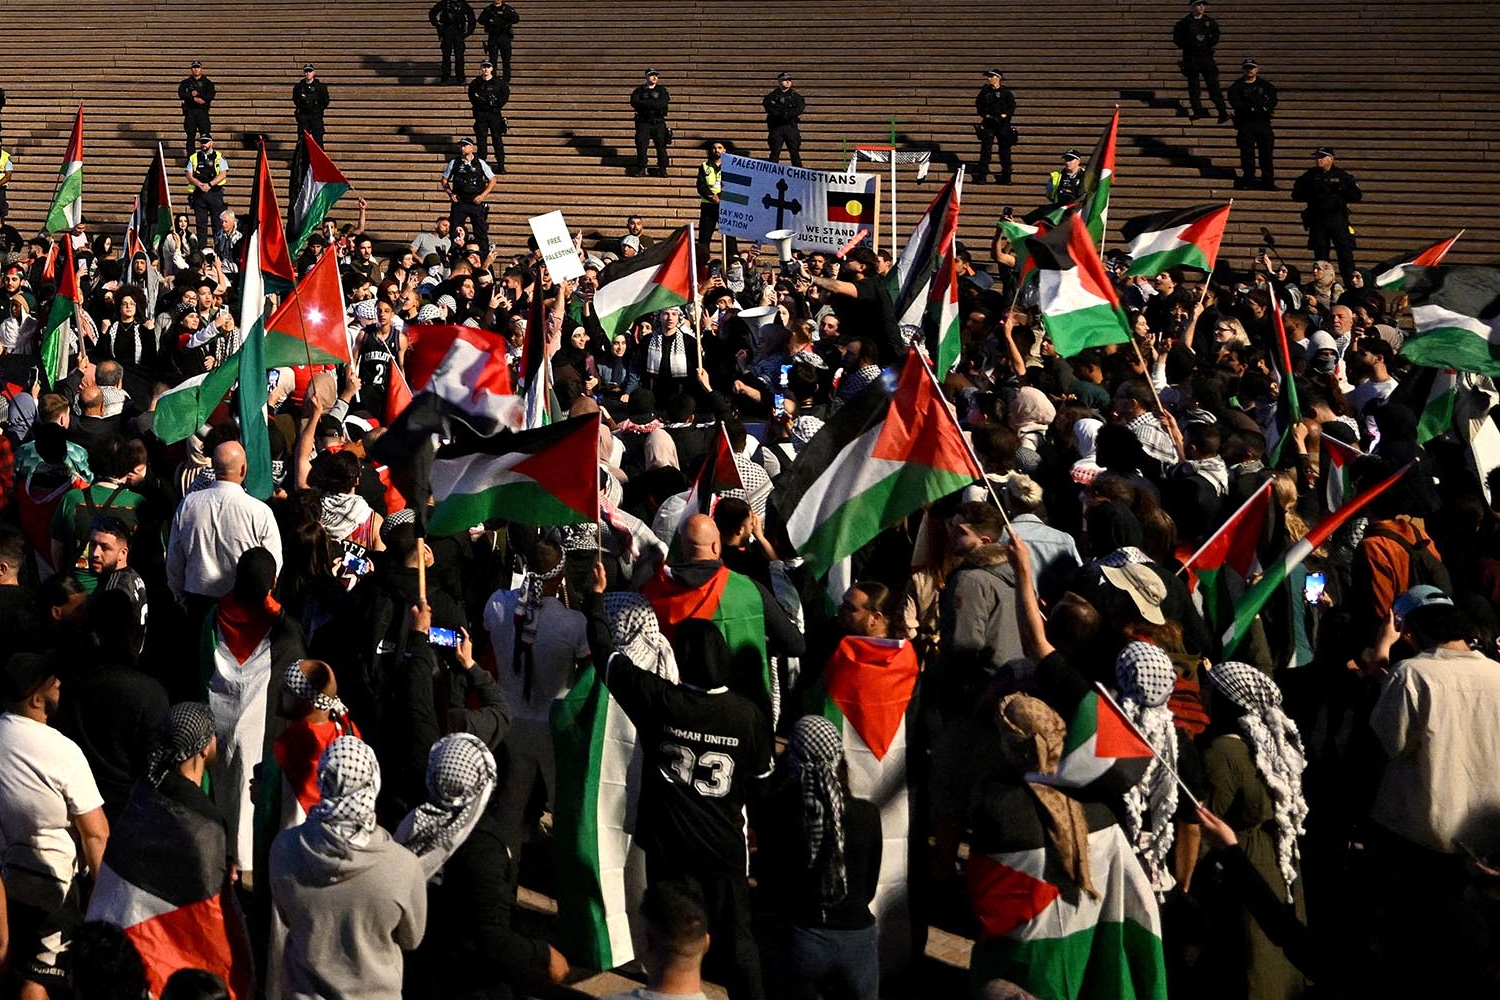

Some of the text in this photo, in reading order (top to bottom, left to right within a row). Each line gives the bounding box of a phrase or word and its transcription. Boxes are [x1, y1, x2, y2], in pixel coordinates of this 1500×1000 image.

[731, 156, 857, 185] PALESTINIAN CHRISTIANS
[733, 212, 744, 220] NO
[745, 214, 754, 223] TO
[805, 224, 820, 234] WE
[823, 227, 855, 237] STAND
[546, 236, 562, 246] FREE
[797, 233, 834, 245] JUSTICE
[837, 237, 845, 246] &
[544, 247, 576, 262] PALESTINE
[373, 363, 384, 384] 2
[704, 734, 739, 747] UNITED
